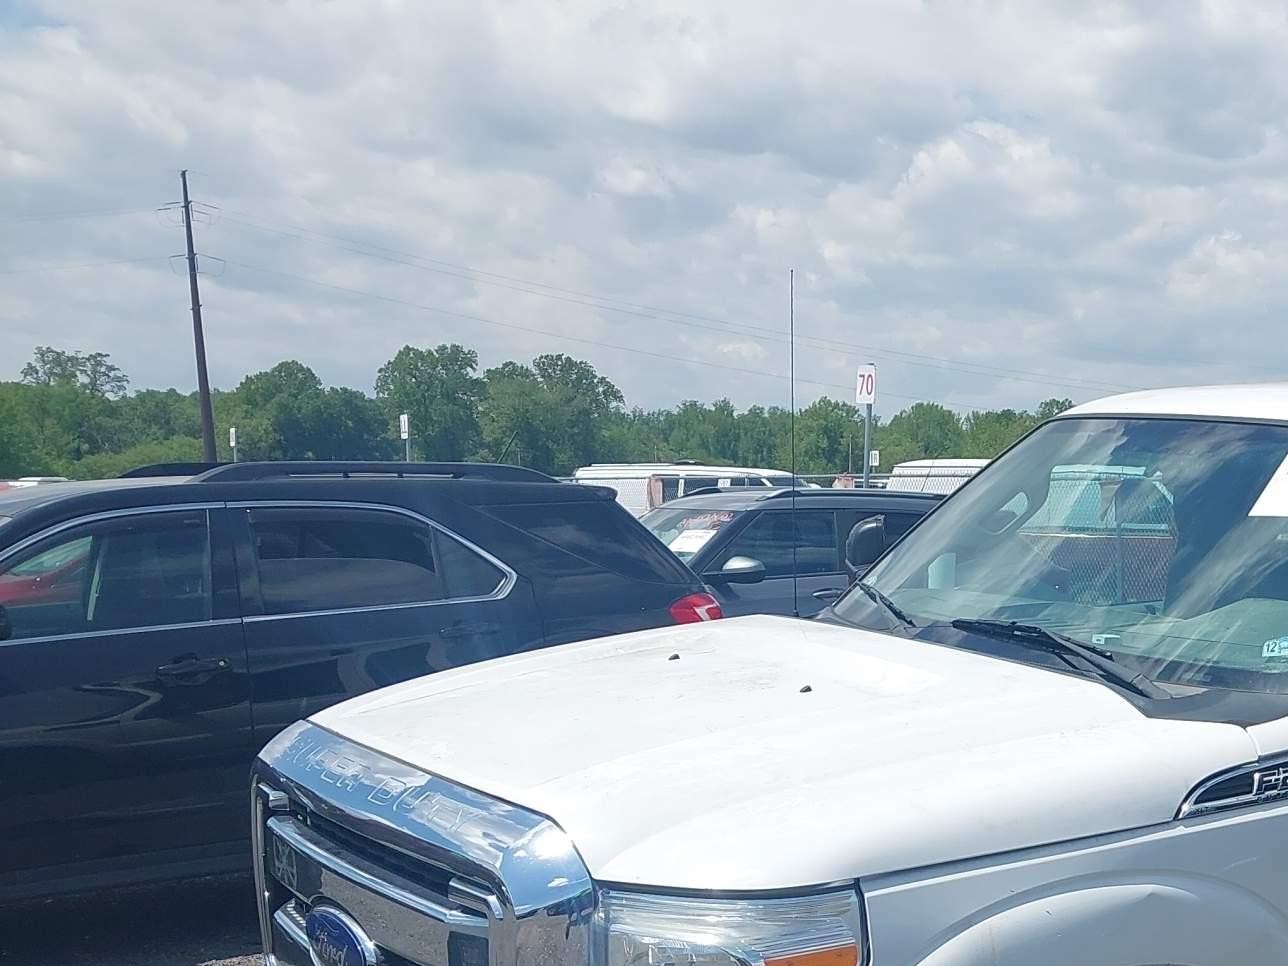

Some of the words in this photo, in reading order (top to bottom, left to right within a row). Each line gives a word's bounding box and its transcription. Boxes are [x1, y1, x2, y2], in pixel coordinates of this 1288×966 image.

[859, 373, 874, 396] 70
[1266, 641, 1278, 653] 12
[286, 736, 371, 793] SUPER
[367, 776, 484, 833] DUTY
